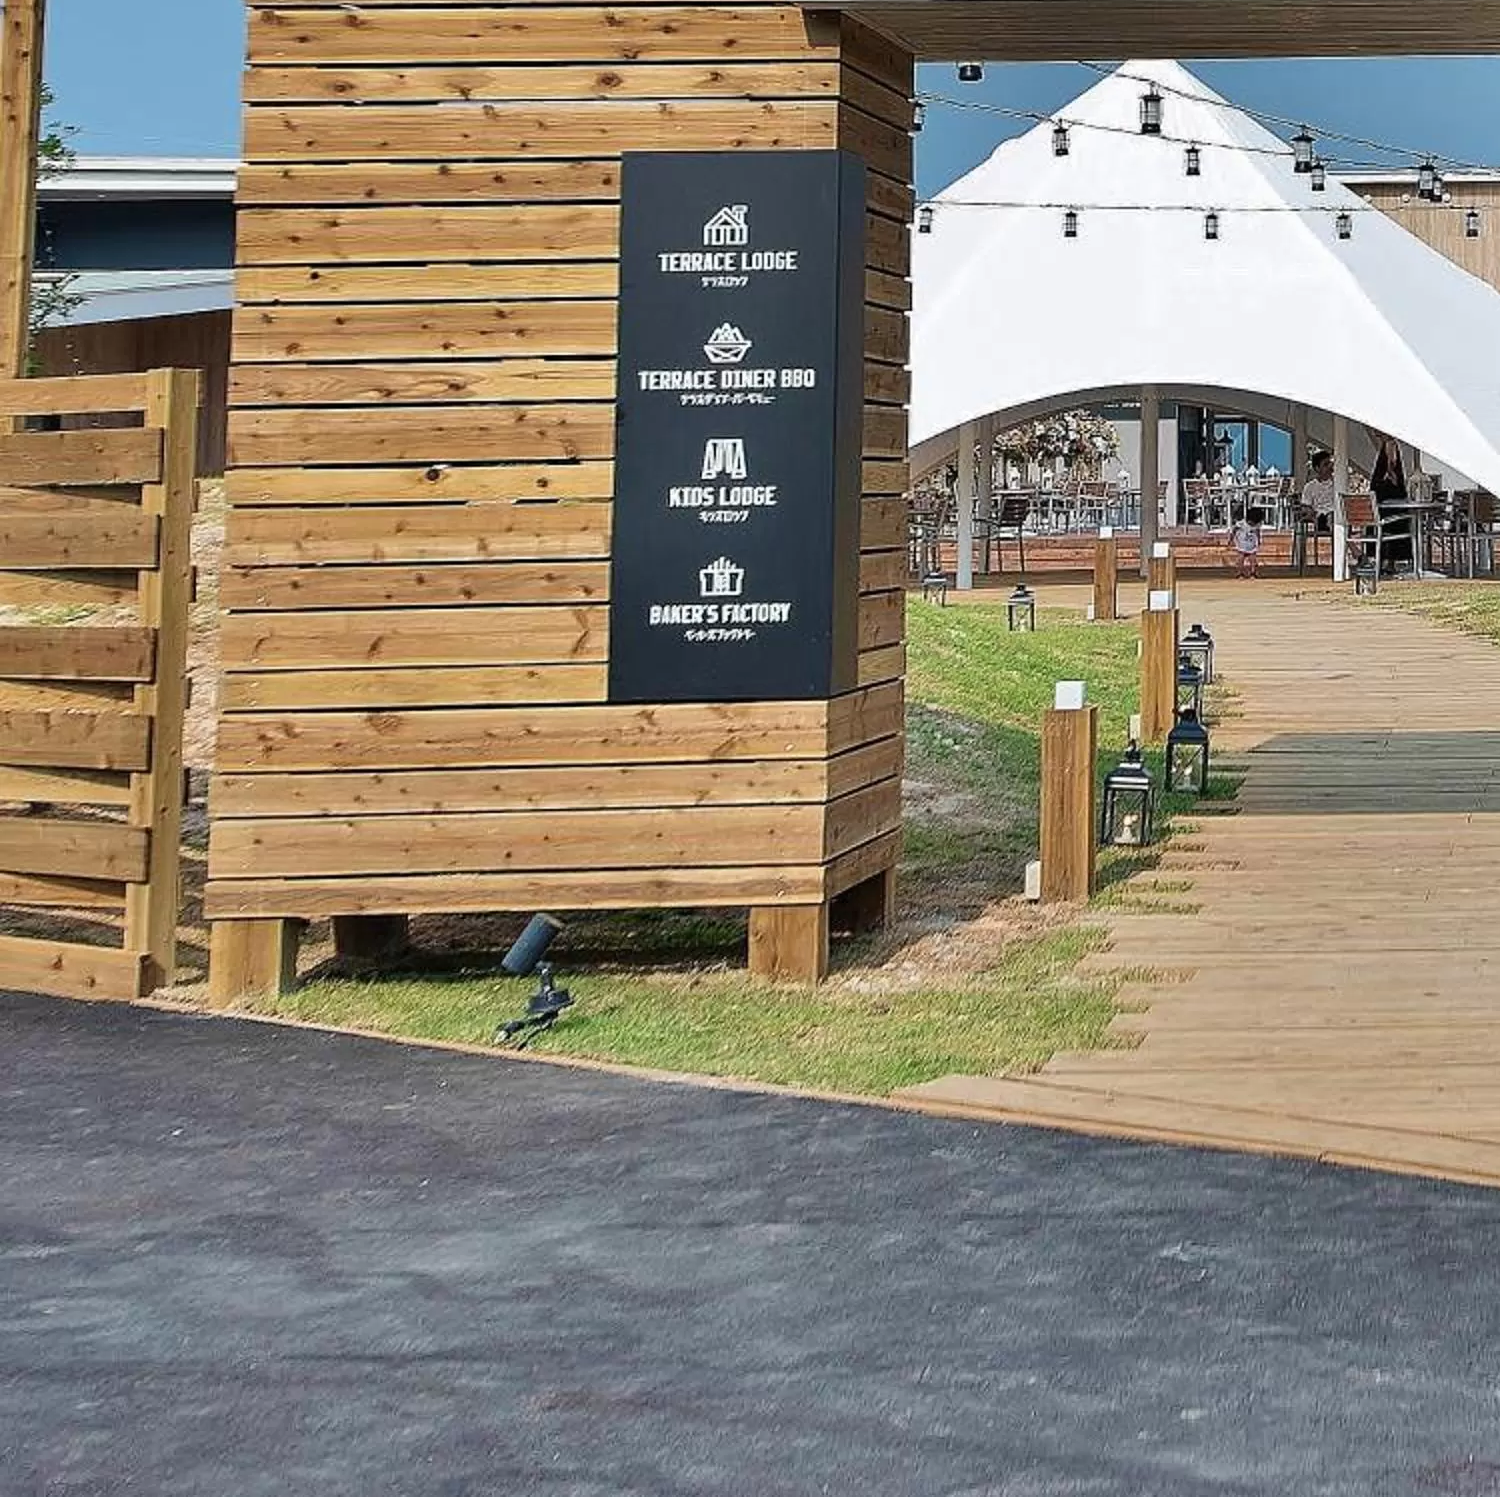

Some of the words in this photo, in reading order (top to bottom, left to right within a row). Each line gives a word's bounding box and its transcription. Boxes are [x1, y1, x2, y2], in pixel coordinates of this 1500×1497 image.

[658, 252, 736, 272] TERRACE
[742, 250, 798, 270] LODGE
[638, 370, 717, 390] TERRACE
[721, 369, 776, 389] DINER
[781, 368, 815, 388] BBQ
[669, 487, 714, 507] KIDS
[720, 486, 777, 506] LODGE
[650, 604, 718, 625] BAKER'S
[721, 603, 791, 624] FACTORY
